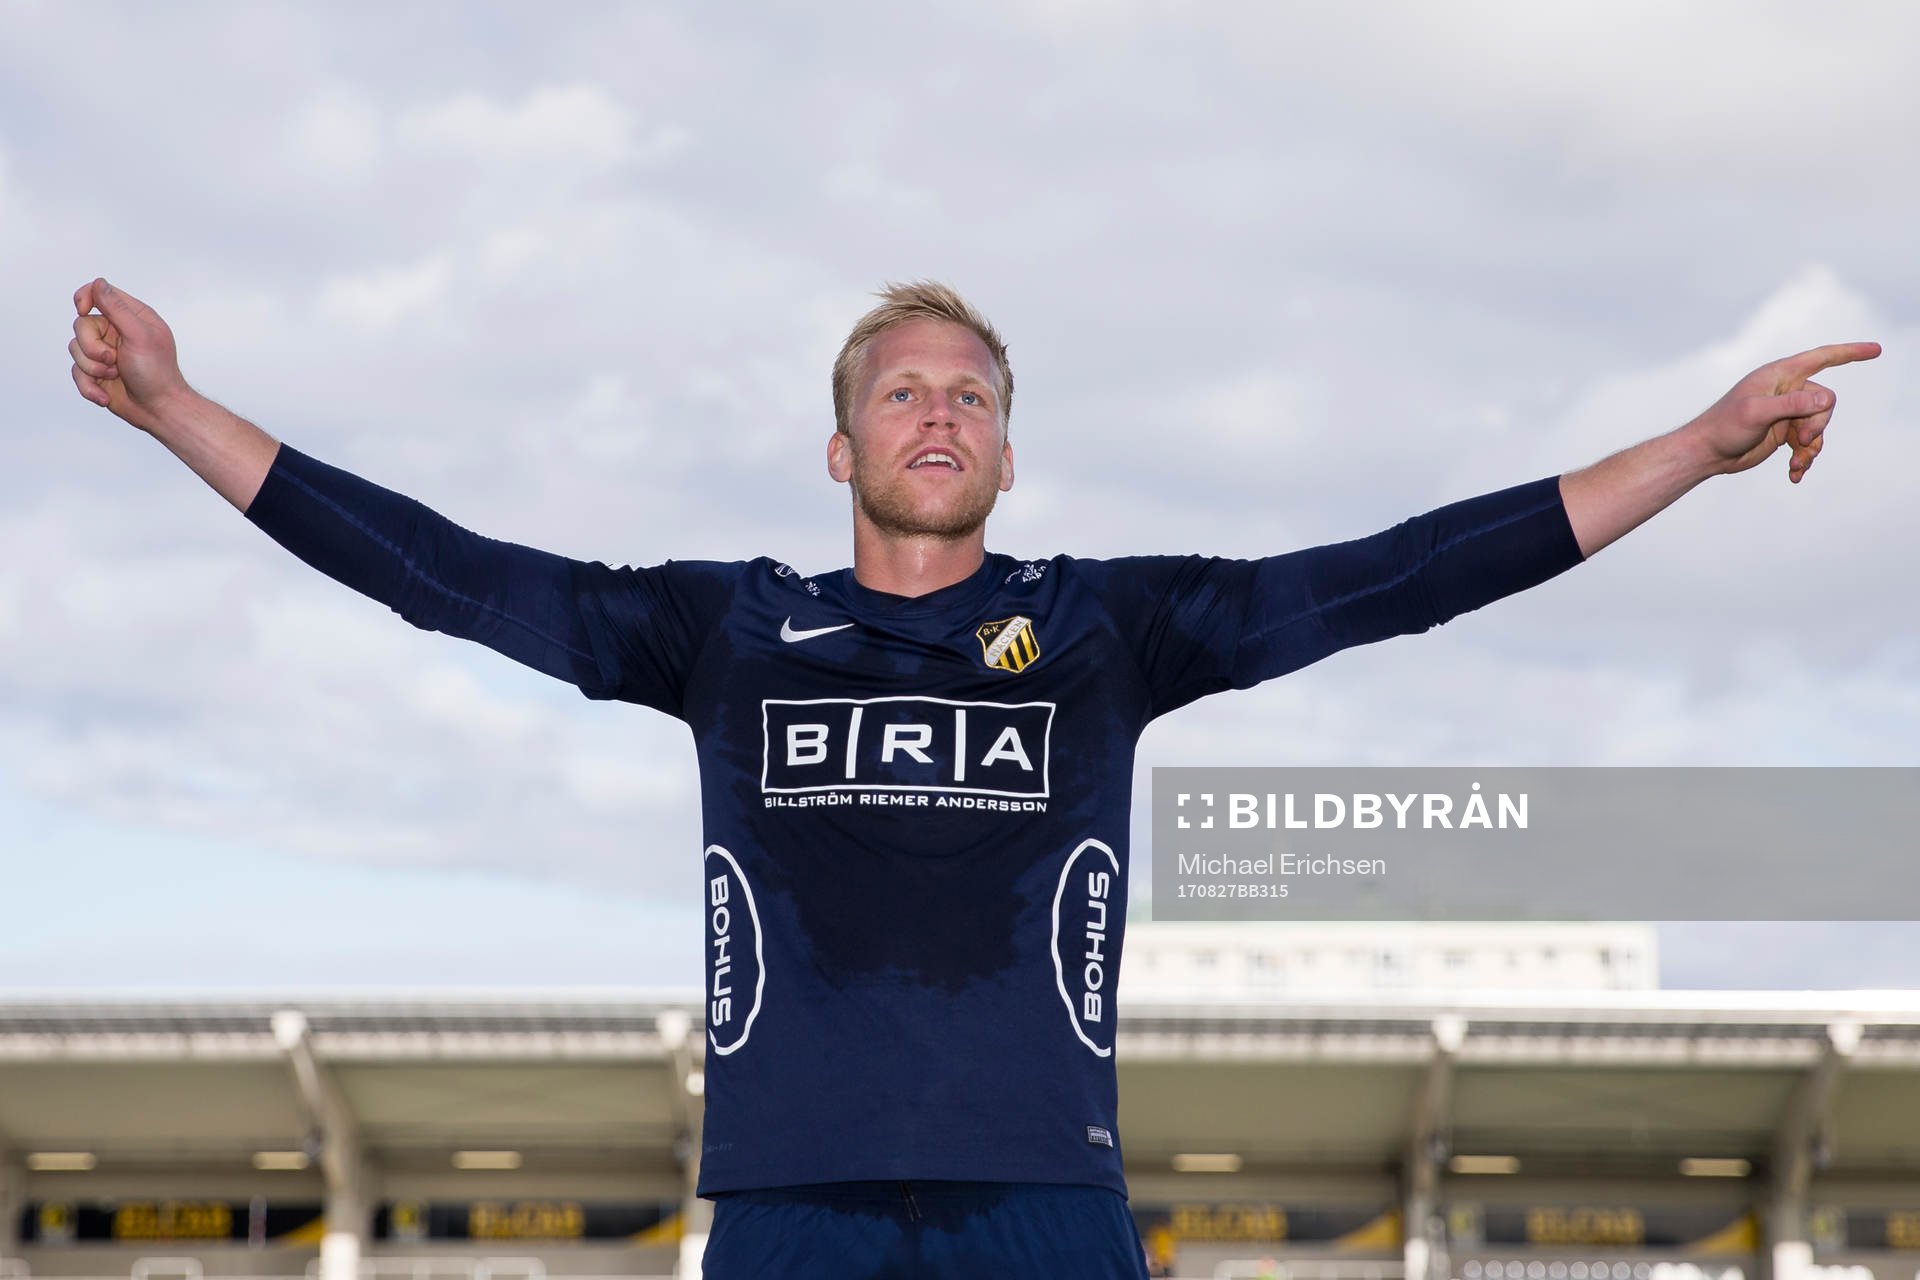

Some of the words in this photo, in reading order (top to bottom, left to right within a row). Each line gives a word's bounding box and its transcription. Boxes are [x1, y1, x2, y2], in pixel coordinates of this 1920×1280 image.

[764, 791, 852, 809] BILLSTRÖM
[859, 794, 929, 807] RIEMER
[935, 796, 1047, 813] ANDERSSON
[710, 874, 732, 1027] BOHUS
[1083, 871, 1110, 1023] BOHUS
